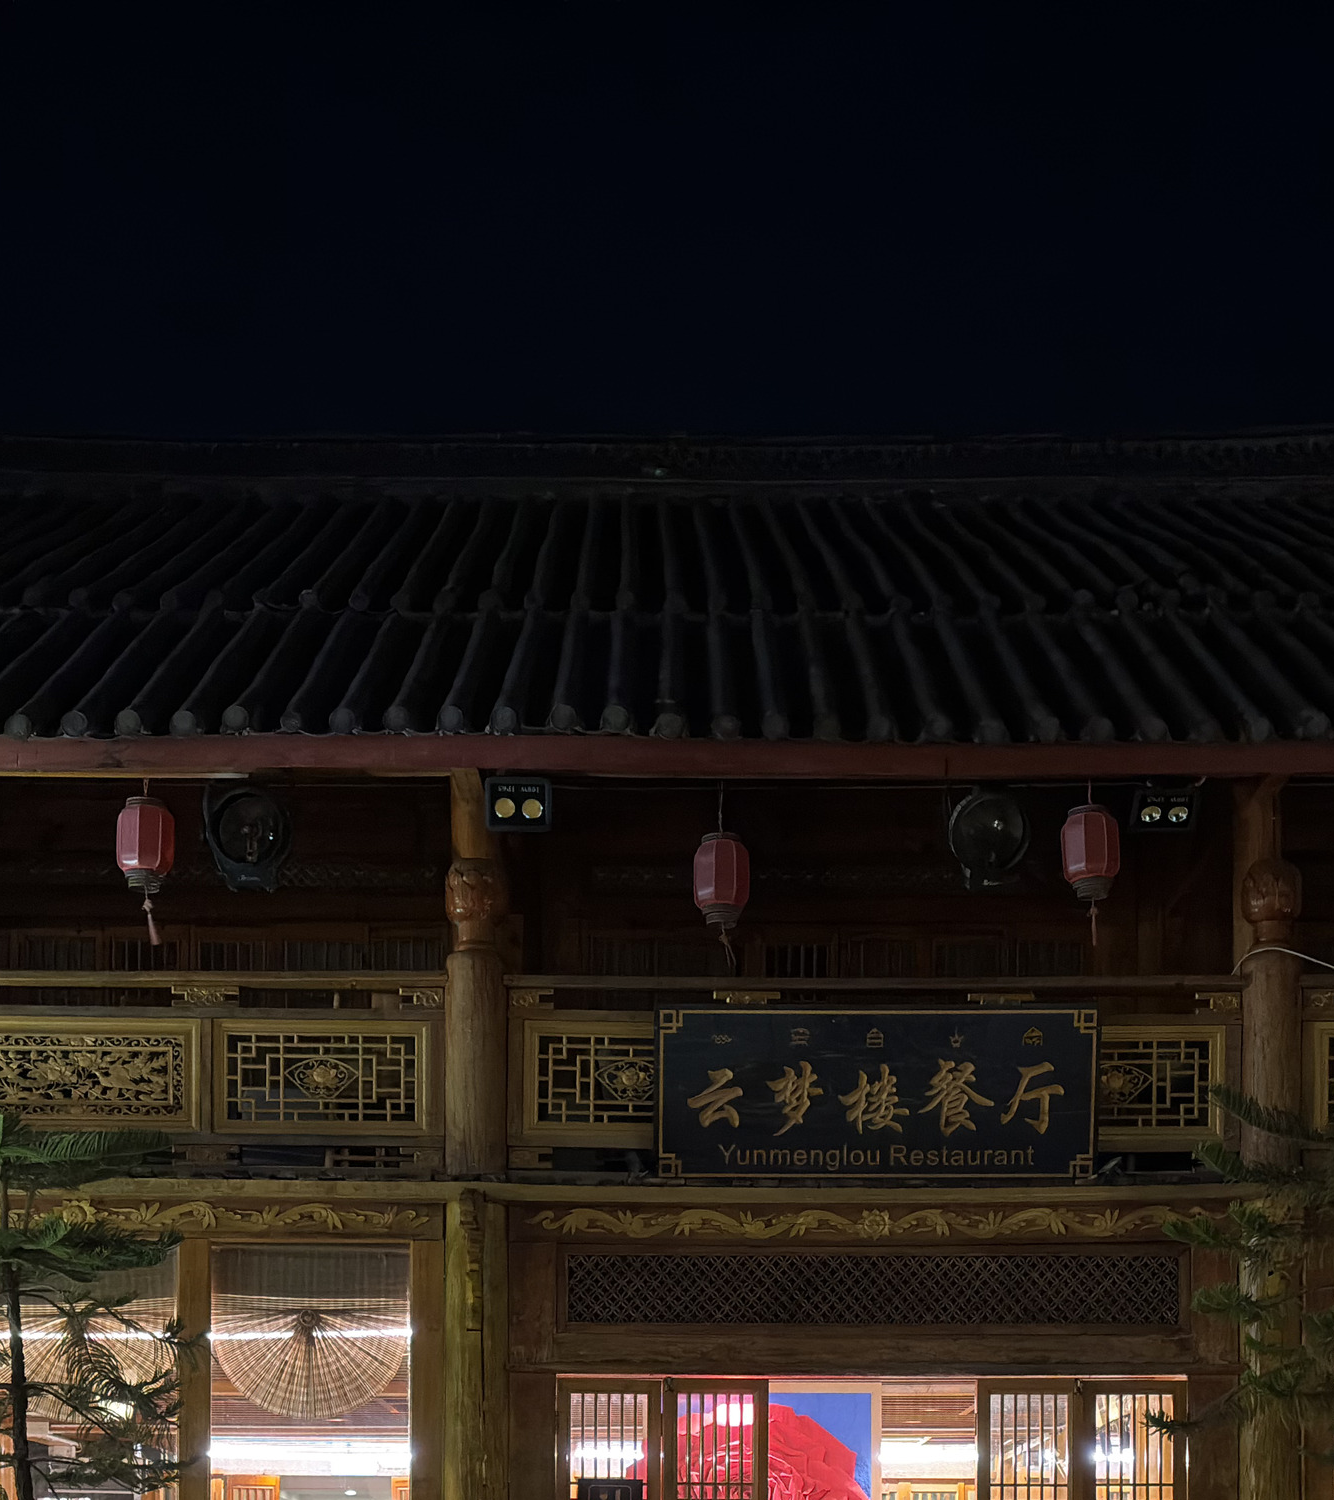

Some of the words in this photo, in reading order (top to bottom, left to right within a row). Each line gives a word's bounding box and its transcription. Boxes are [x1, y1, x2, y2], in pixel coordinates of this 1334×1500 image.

[686, 1057, 1066, 1137] 云梦楼餐厅
[717, 1143, 881, 1172] Yunmenglou
[889, 1143, 1035, 1167] Restaurant
